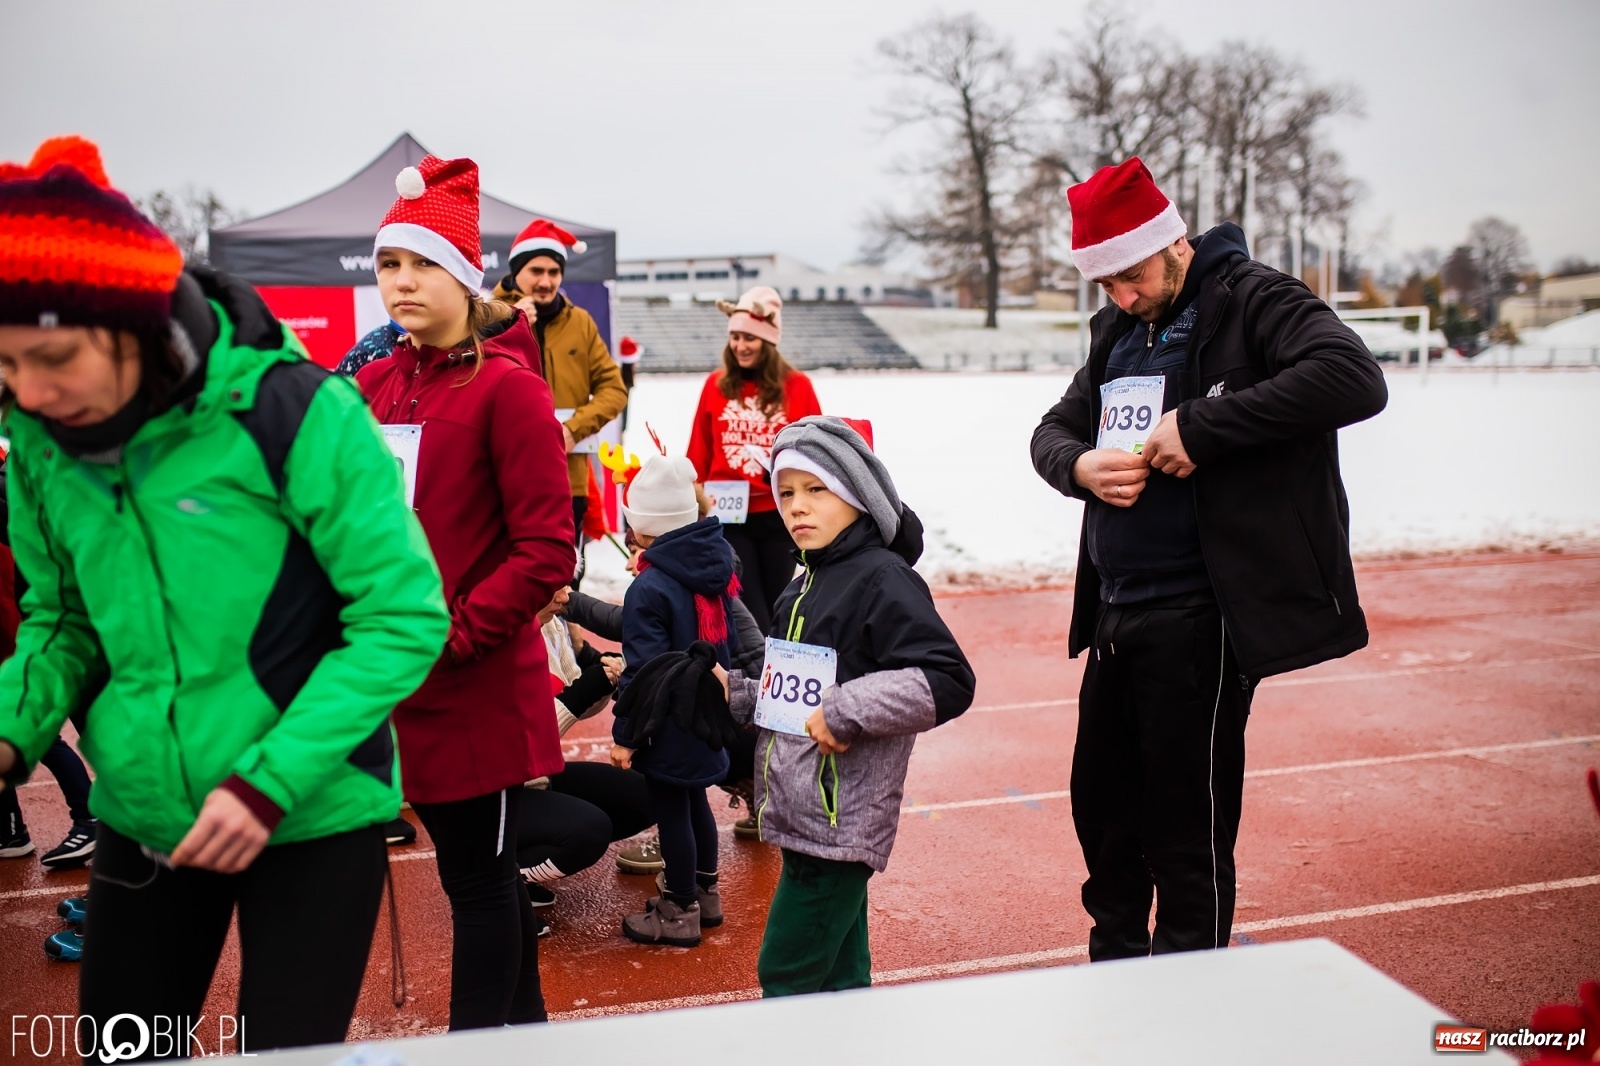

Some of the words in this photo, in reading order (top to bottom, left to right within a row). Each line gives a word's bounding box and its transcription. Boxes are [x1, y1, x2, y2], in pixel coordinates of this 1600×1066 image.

[728, 419, 778, 433] HAPPY
[1106, 405, 1152, 431] 039
[718, 496, 743, 510] 028
[770, 671, 822, 707] 038
